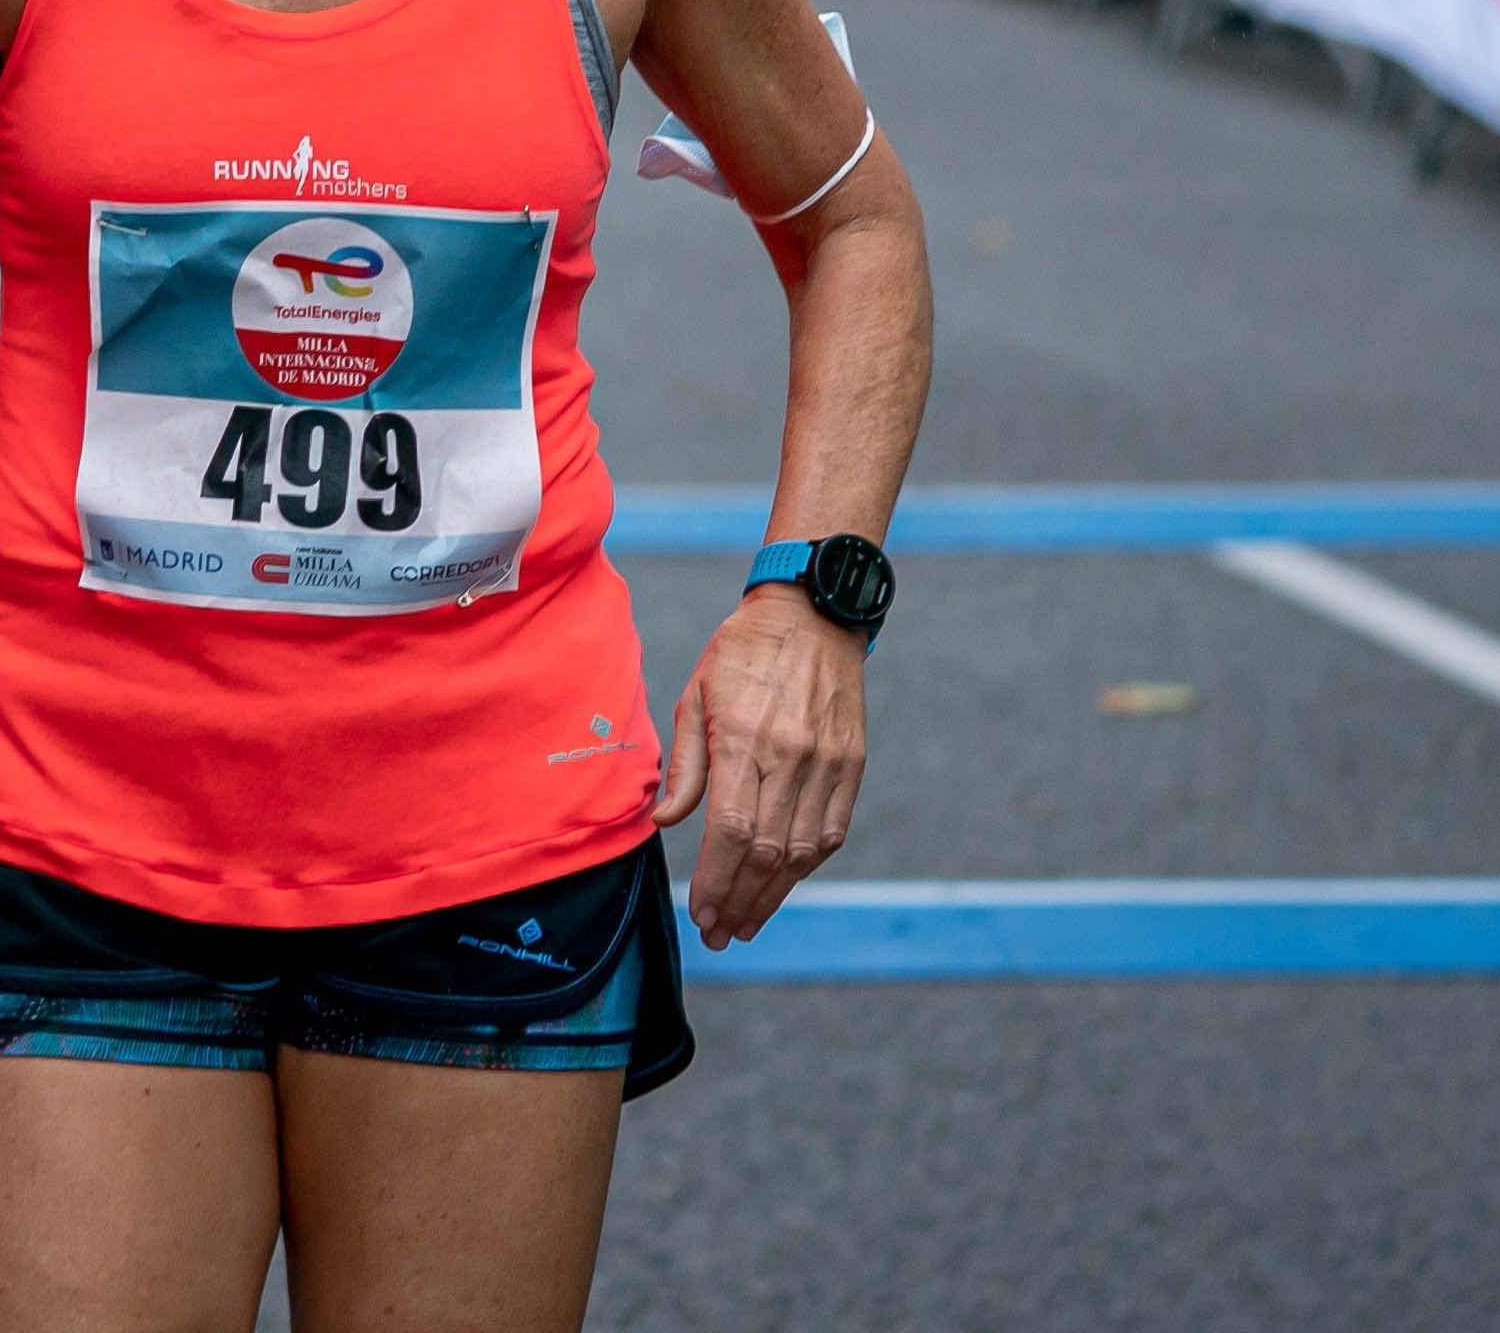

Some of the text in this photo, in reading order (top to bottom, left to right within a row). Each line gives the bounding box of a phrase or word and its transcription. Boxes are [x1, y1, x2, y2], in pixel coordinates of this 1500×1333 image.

[312, 178, 407, 200] mothers
[273, 304, 381, 325] TotalEnergies
[296, 336, 349, 354] MILLA
[277, 369, 367, 388] DE MADRID
[200, 404, 423, 532] 499
[126, 545, 224, 574] MADRID
[296, 555, 354, 573] MILLA
